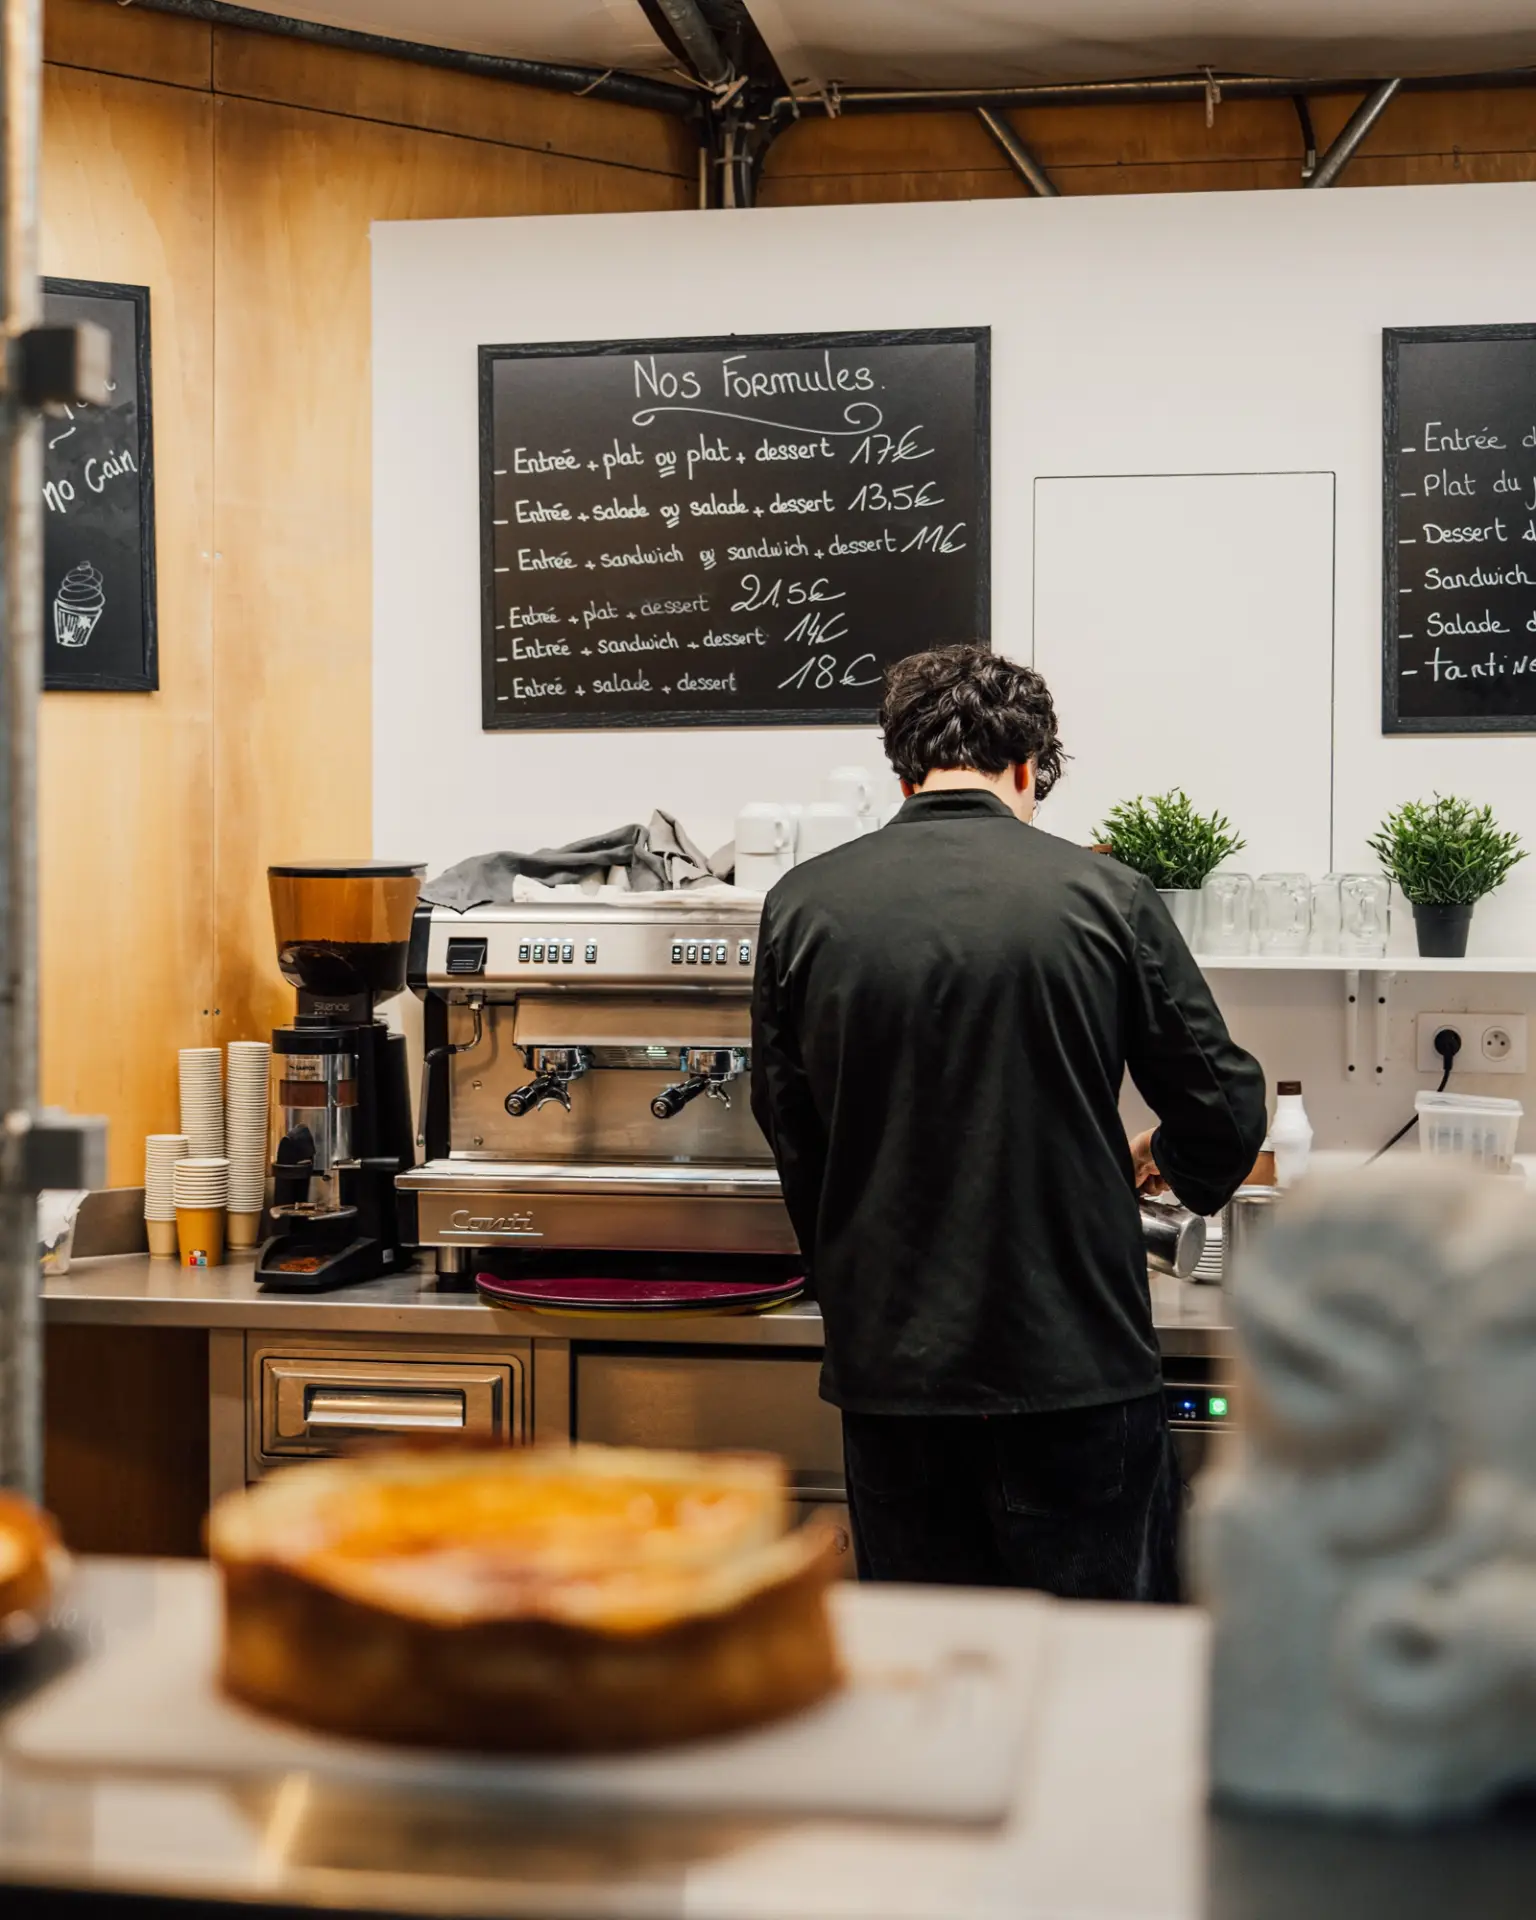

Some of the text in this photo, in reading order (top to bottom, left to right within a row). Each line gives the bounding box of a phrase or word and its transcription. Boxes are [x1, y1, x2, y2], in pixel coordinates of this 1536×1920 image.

[633, 355, 702, 400] Nos
[602, 437, 645, 481] plat
[686, 433, 733, 481] plat
[755, 437, 836, 463] dessert
[848, 425, 936, 466] 17€
[1425, 421, 1507, 453] Entrée
[84, 448, 139, 494] Gain
[1424, 467, 1477, 498] Plat
[1492, 468, 1523, 494] du
[591, 493, 651, 523] salade
[688, 487, 750, 518] salade
[768, 489, 836, 515] dessert
[599, 542, 685, 569] sandwich
[726, 534, 810, 562] sandwich
[827, 527, 898, 558] dessert
[899, 521, 967, 554] 11€
[1422, 516, 1509, 545] Dessert
[1423, 563, 1536, 591] Sandwich
[582, 599, 620, 631] plat
[640, 593, 711, 617] dessert
[1425, 608, 1511, 638] Salade
[597, 630, 680, 655] sandwich
[701, 626, 767, 648] dessert
[783, 612, 849, 647] 14€
[591, 668, 654, 694] salade
[676, 671, 737, 693] dessert
[776, 653, 884, 690] 18€
